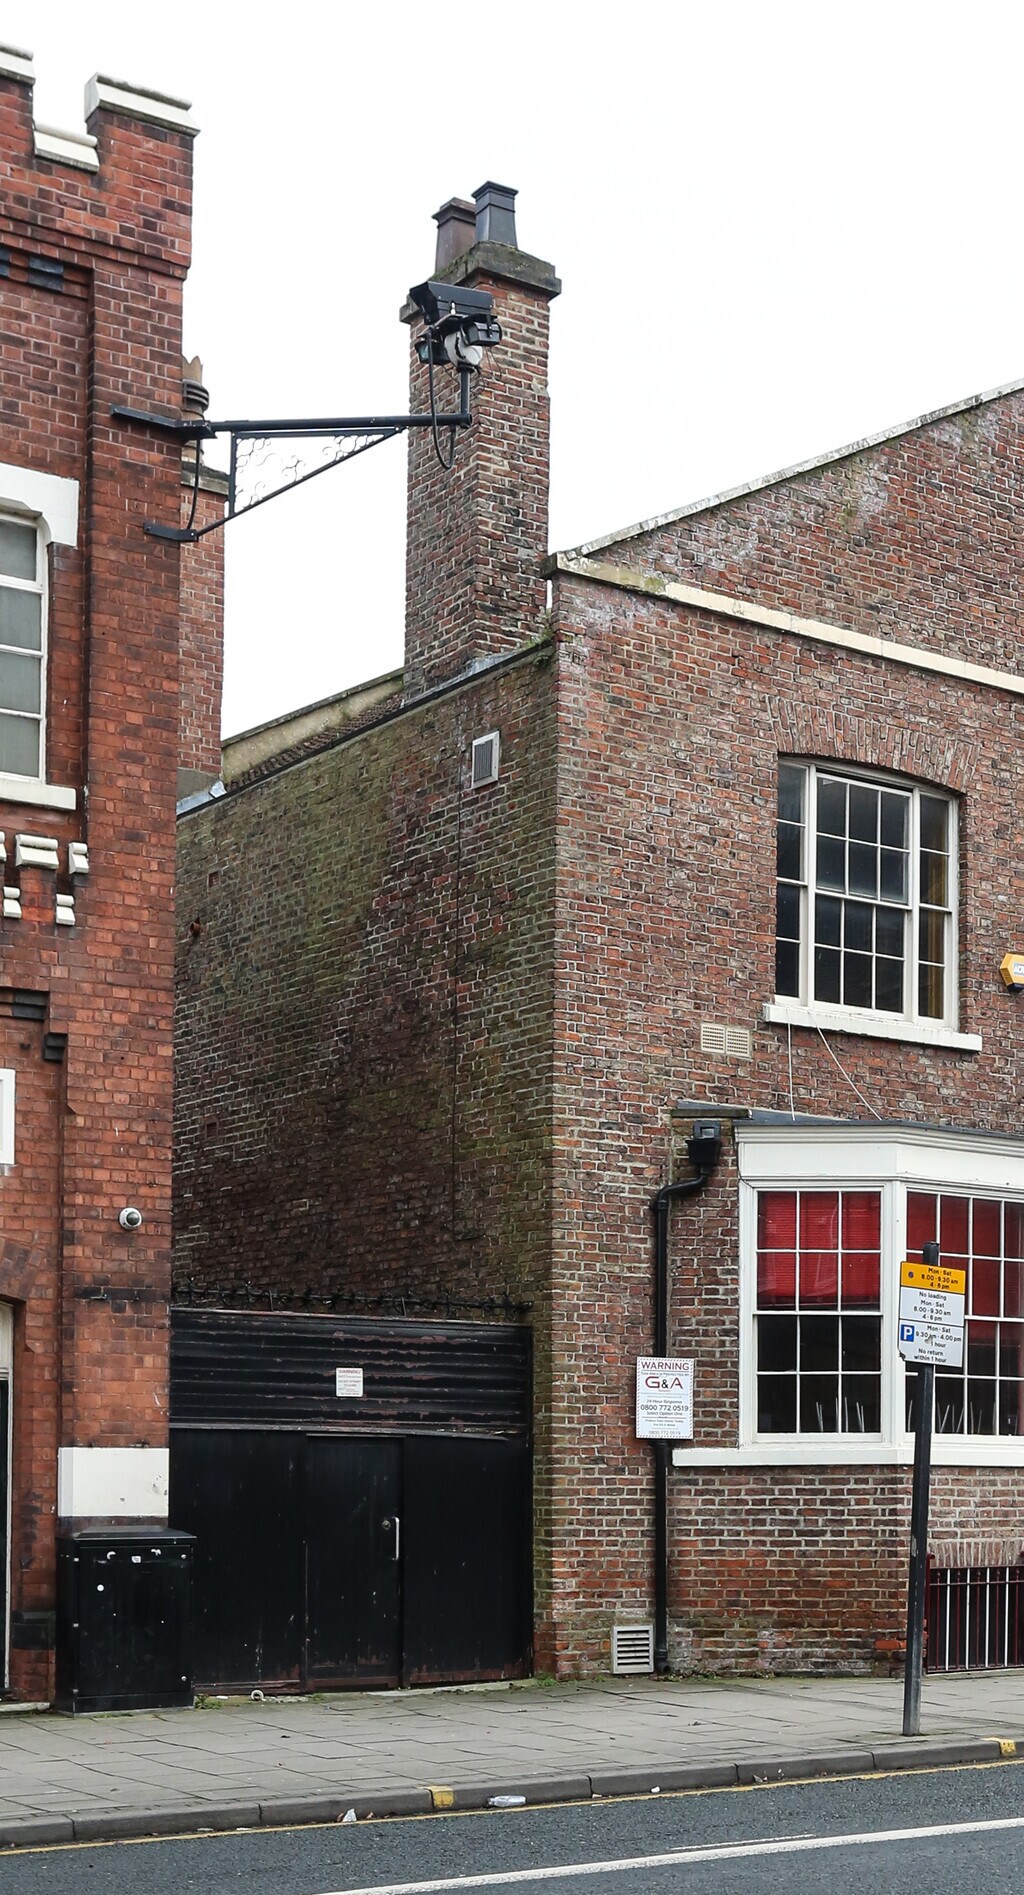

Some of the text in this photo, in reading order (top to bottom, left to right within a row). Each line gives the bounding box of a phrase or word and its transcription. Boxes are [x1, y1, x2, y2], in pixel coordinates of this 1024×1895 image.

[928, 1292, 946, 1300] loading
[904, 1326, 912, 1340] P
[641, 1362, 689, 1370] WARNING
[645, 1376, 683, 1390] G&A
